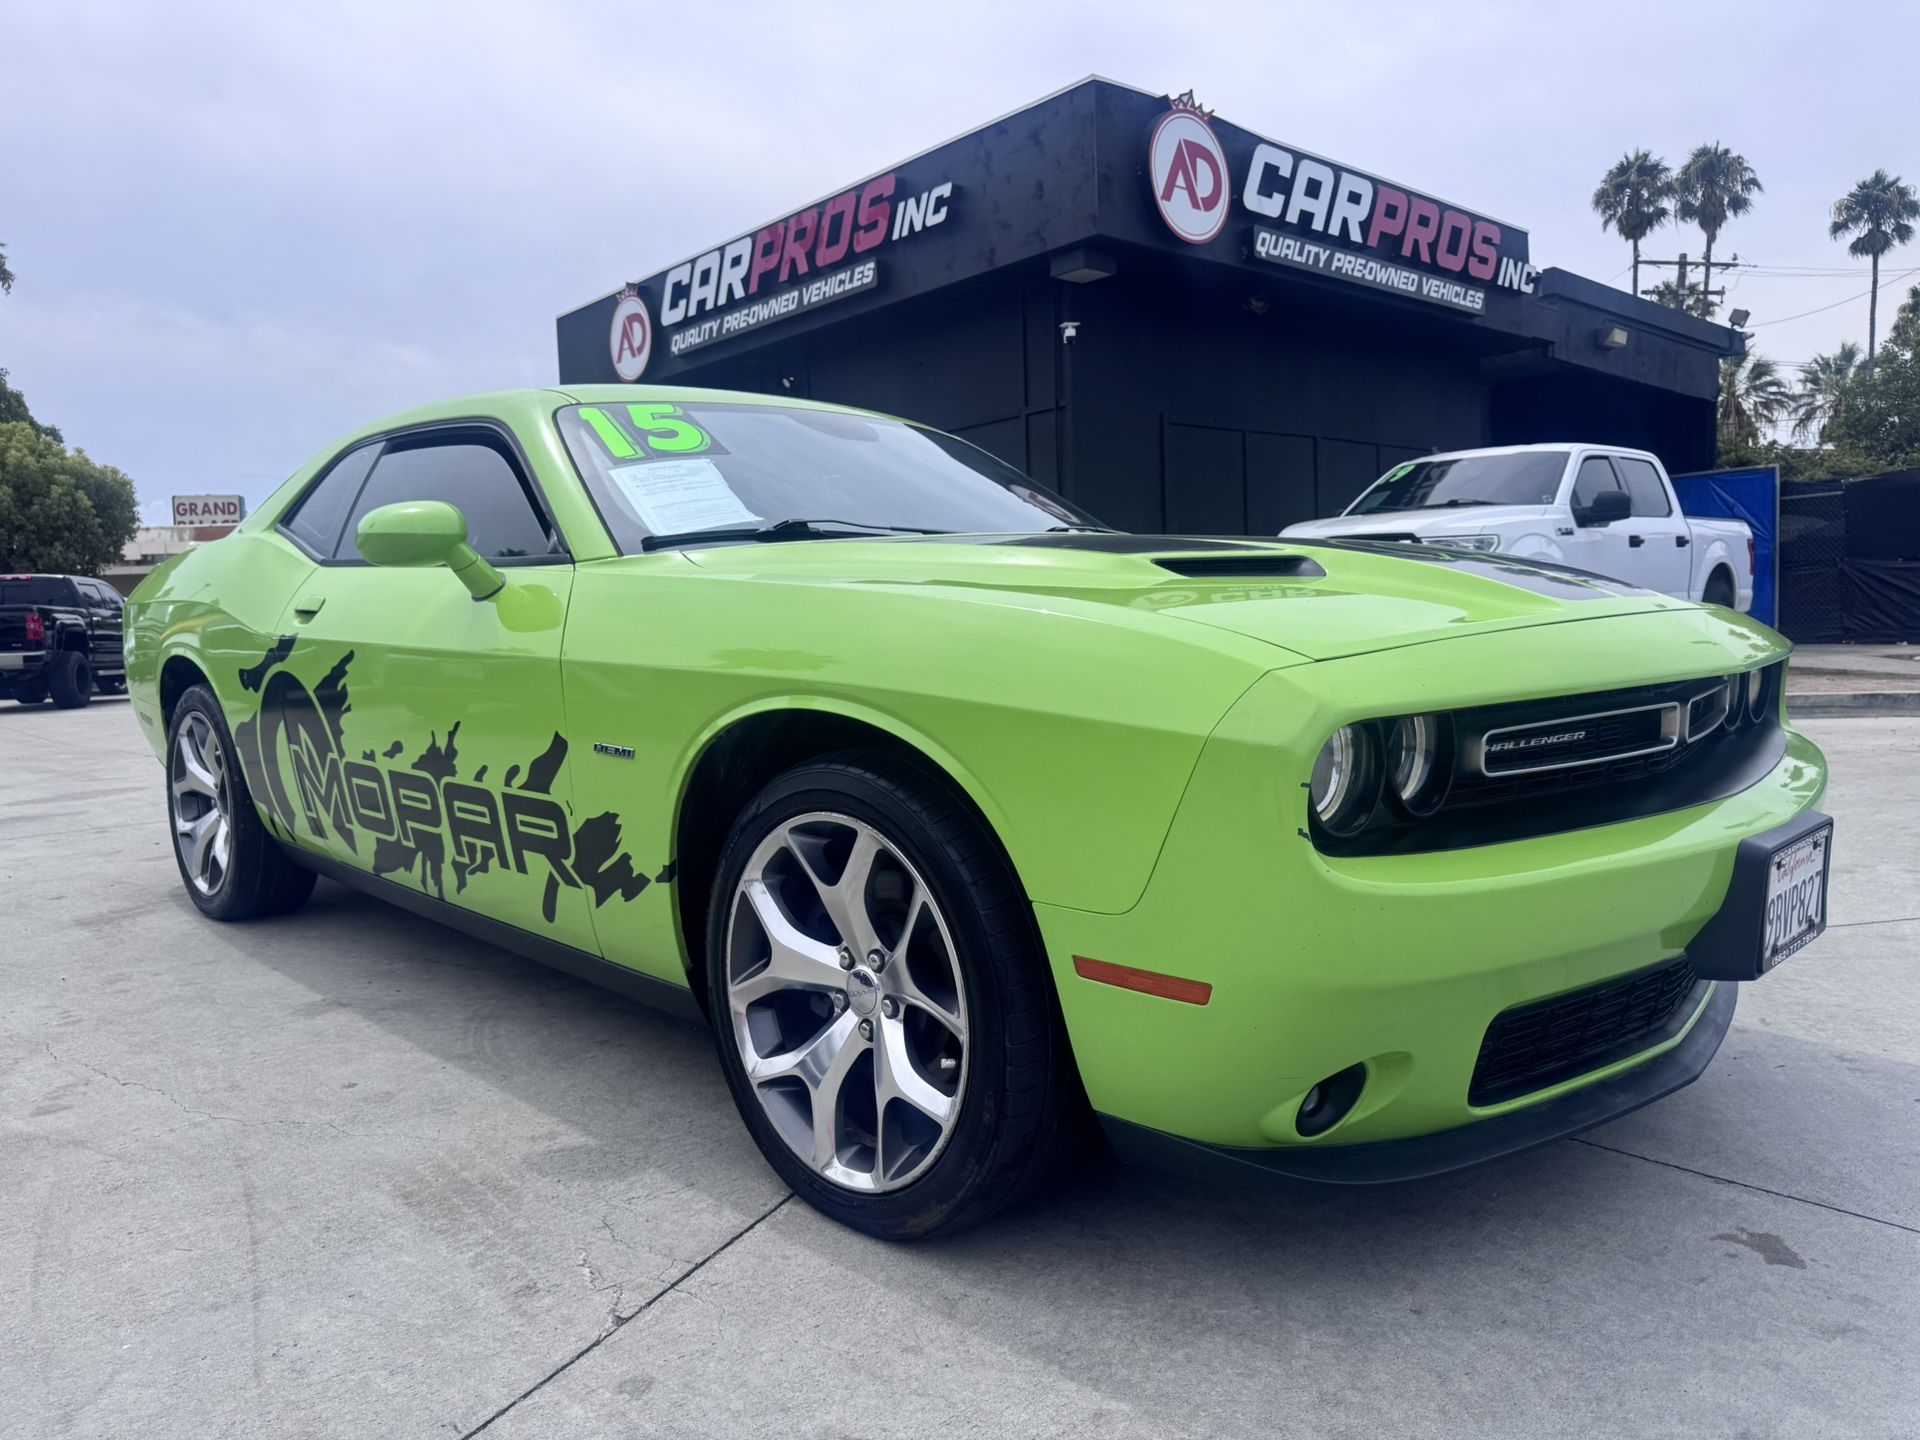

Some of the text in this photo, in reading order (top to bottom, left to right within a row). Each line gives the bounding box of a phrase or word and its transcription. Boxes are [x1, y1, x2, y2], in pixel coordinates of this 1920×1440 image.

[891, 181, 952, 241] INC
[1256, 231, 1330, 268] QUALITY
[1421, 276, 1484, 310] VEHICLES
[1497, 256, 1537, 294] INC
[671, 319, 720, 355] QUALITY
[802, 261, 875, 305] VEHICLES
[578, 404, 712, 460] 15
[176, 502, 238, 516] GRAND
[594, 742, 635, 760] HEMI
[1484, 731, 1585, 752] HALLENGER
[290, 722, 584, 890] MOPAR
[1765, 869, 1823, 952] 9BVP827
